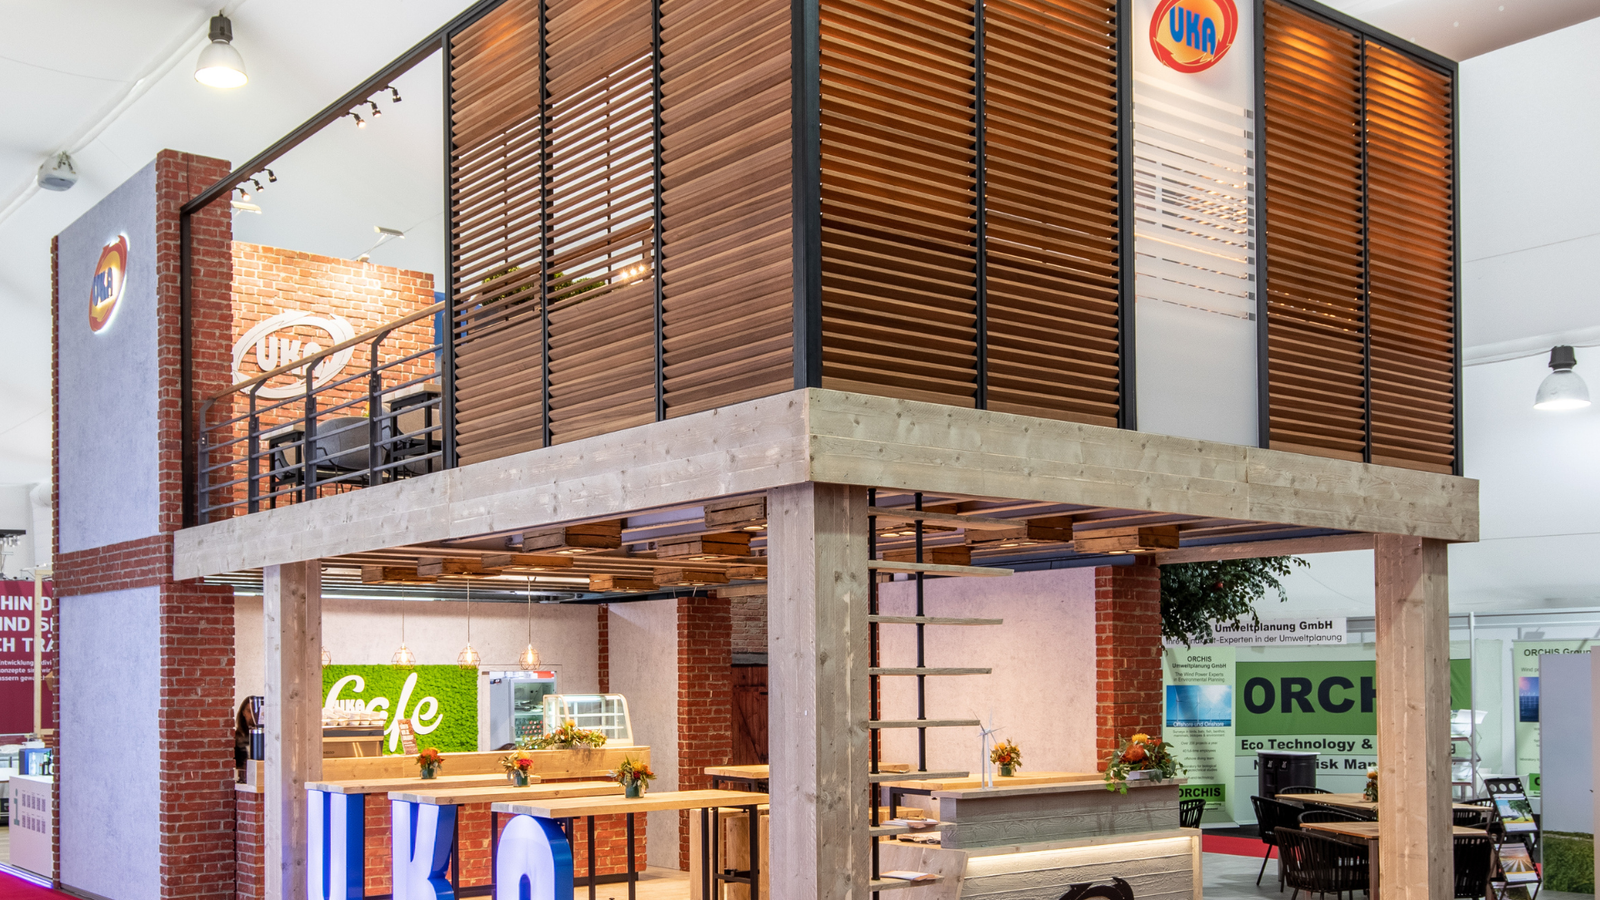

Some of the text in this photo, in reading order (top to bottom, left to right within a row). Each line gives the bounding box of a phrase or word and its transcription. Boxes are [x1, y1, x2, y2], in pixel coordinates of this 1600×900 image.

[1169, 5, 1217, 56] UKA
[92, 266, 114, 307] UKA
[256, 336, 323, 379] UKA
[1214, 620, 1334, 634] Umweltplanung GmbH
[1255, 635, 1262, 644] in
[1264, 634, 1278, 643] der
[1279, 633, 1343, 644] Umweltplanung
[1241, 738, 1373, 752] Eco Technology &
[1315, 758, 1339, 770] isk
[1179, 787, 1221, 798] ORCHIS
